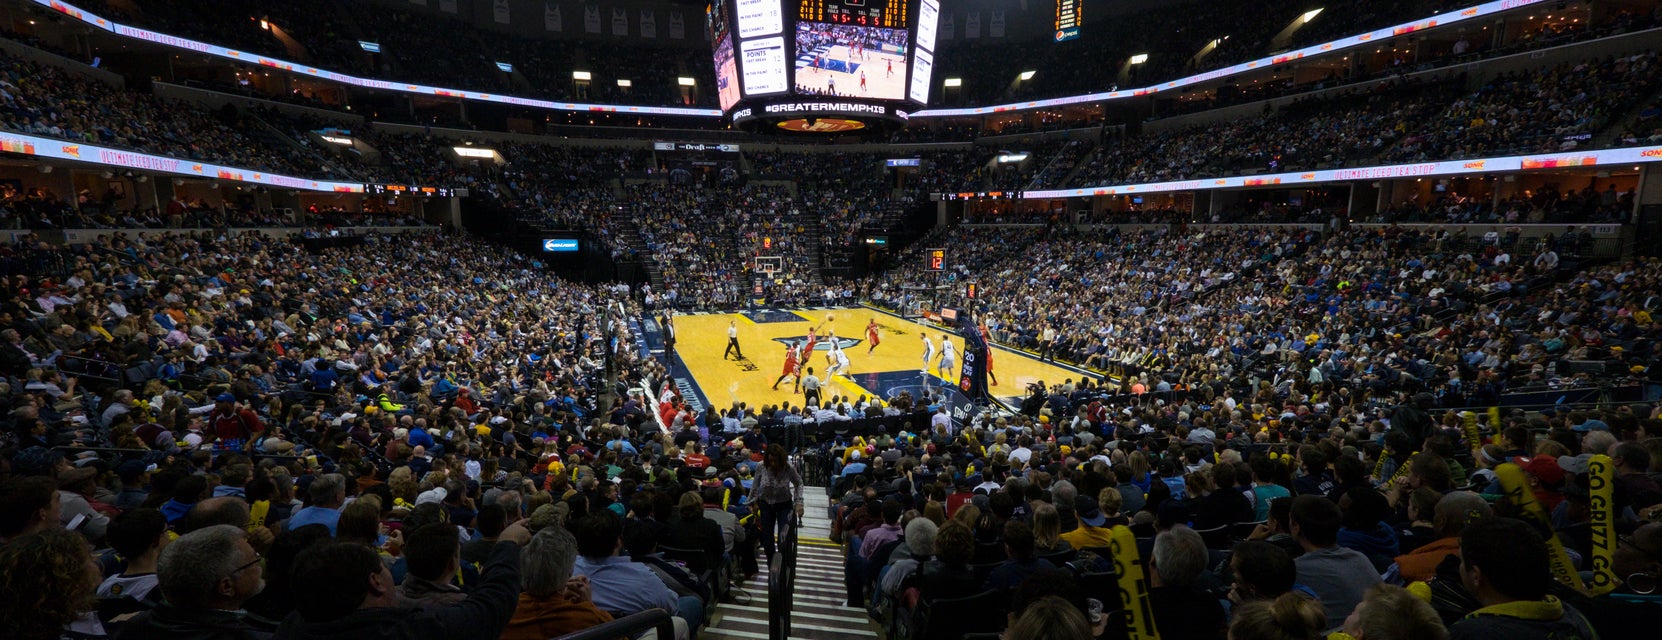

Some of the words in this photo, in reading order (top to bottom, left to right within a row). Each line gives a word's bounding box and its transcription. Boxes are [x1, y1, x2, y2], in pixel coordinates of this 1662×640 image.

[841, 14, 847, 23] 5
[861, 15, 866, 25] 5
[874, 16, 879, 25] 5
[746, 50, 767, 58] POINTS
[765, 103, 885, 114] #GREATERMEMPHIS
[101, 150, 133, 166] ULTIMATE
[136, 155, 150, 169] ICED
[1463, 161, 1485, 169] SONIC
[1334, 169, 1370, 180] ULTIMATE
[1373, 167, 1392, 178] ICED
[1395, 166, 1409, 176] TEA
[932, 257, 943, 269] 12
[1588, 461, 1606, 491] GO
[1592, 555, 1611, 588] GO
